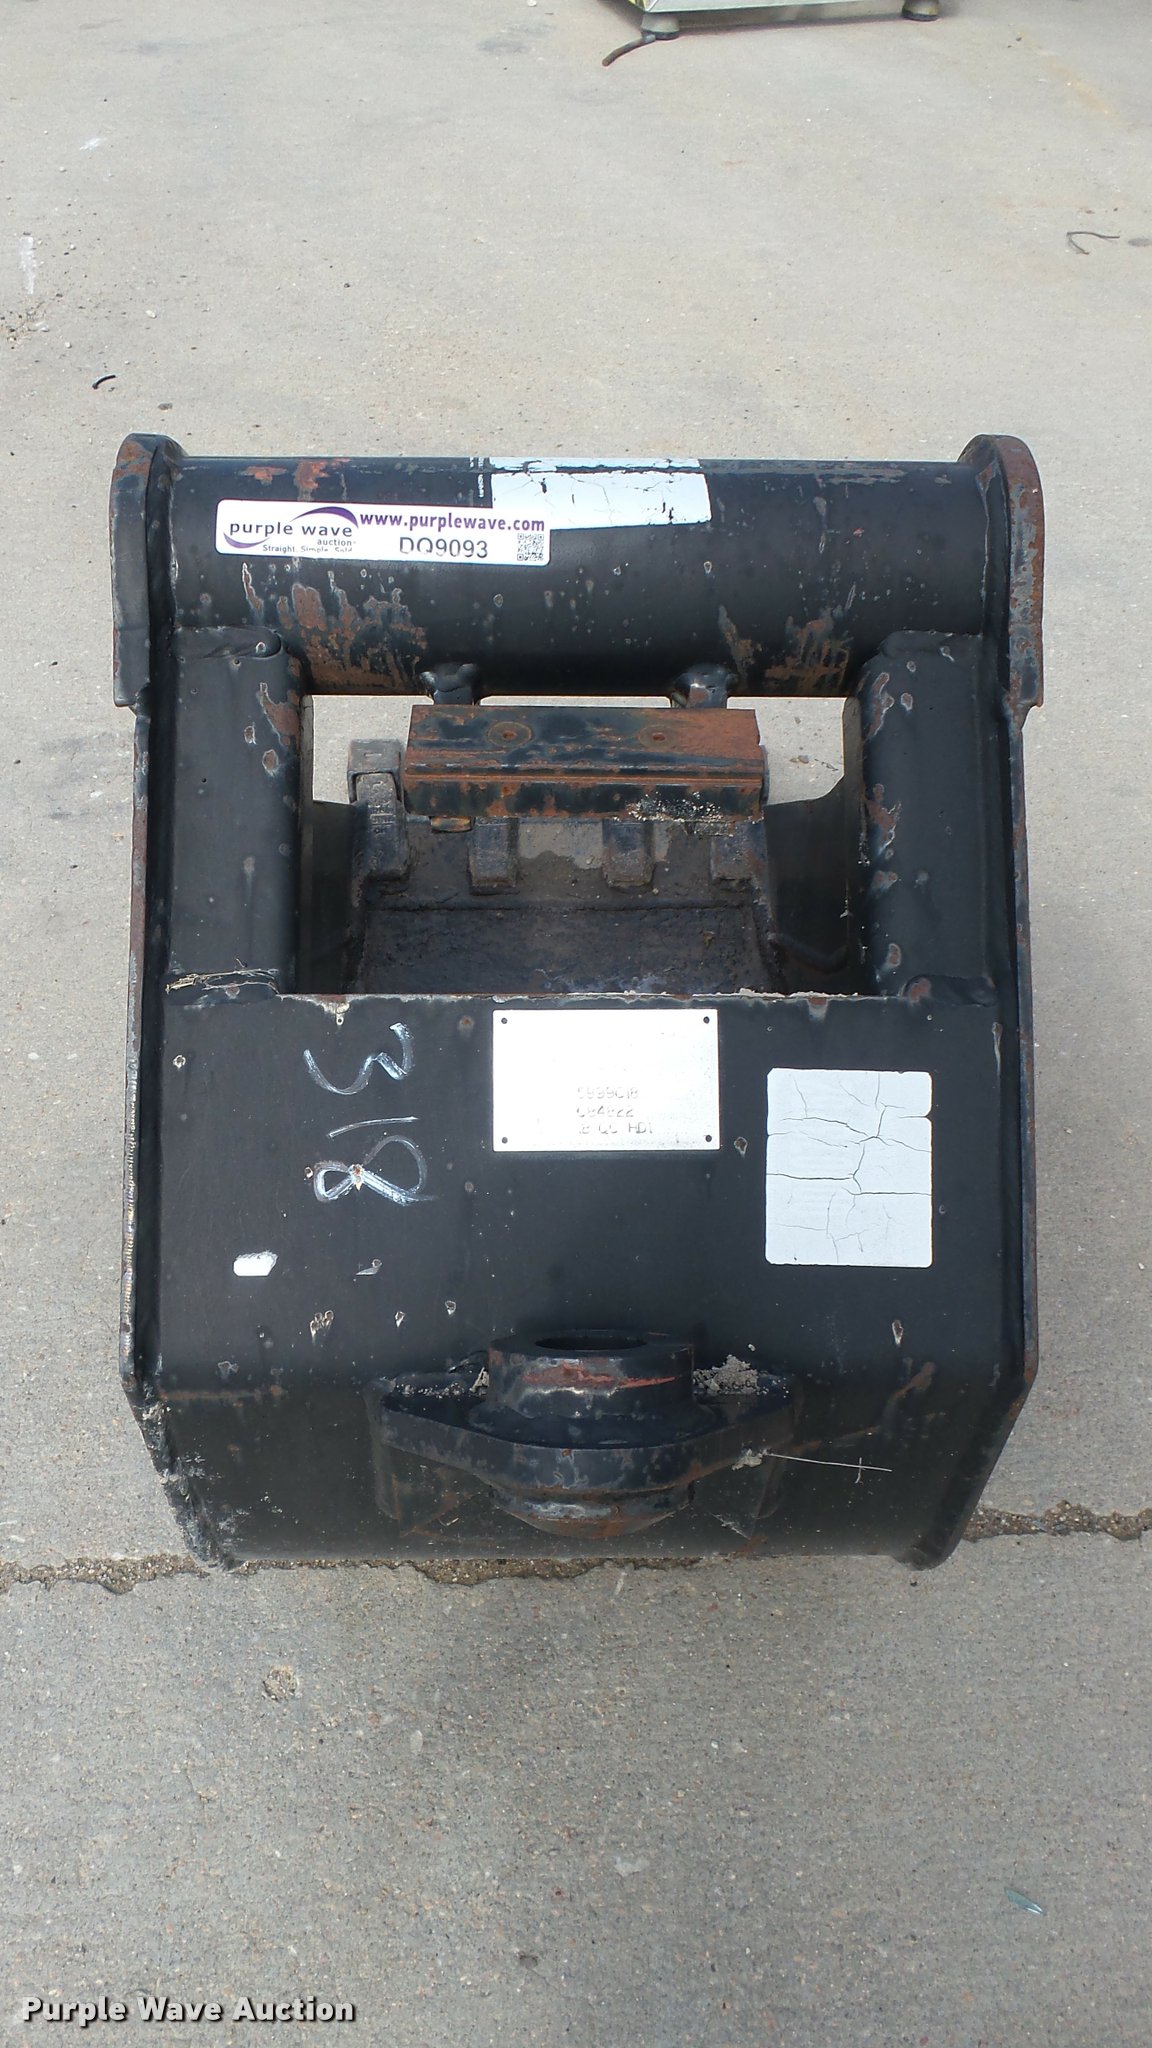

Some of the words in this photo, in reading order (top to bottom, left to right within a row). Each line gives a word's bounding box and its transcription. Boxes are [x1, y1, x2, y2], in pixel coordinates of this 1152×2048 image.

[229, 521, 294, 538] purple
[301, 525, 353, 538] wave
[360, 512, 545, 533] www.purplewave.com
[316, 538, 353, 547] auction
[399, 536, 489, 559] DQ9093
